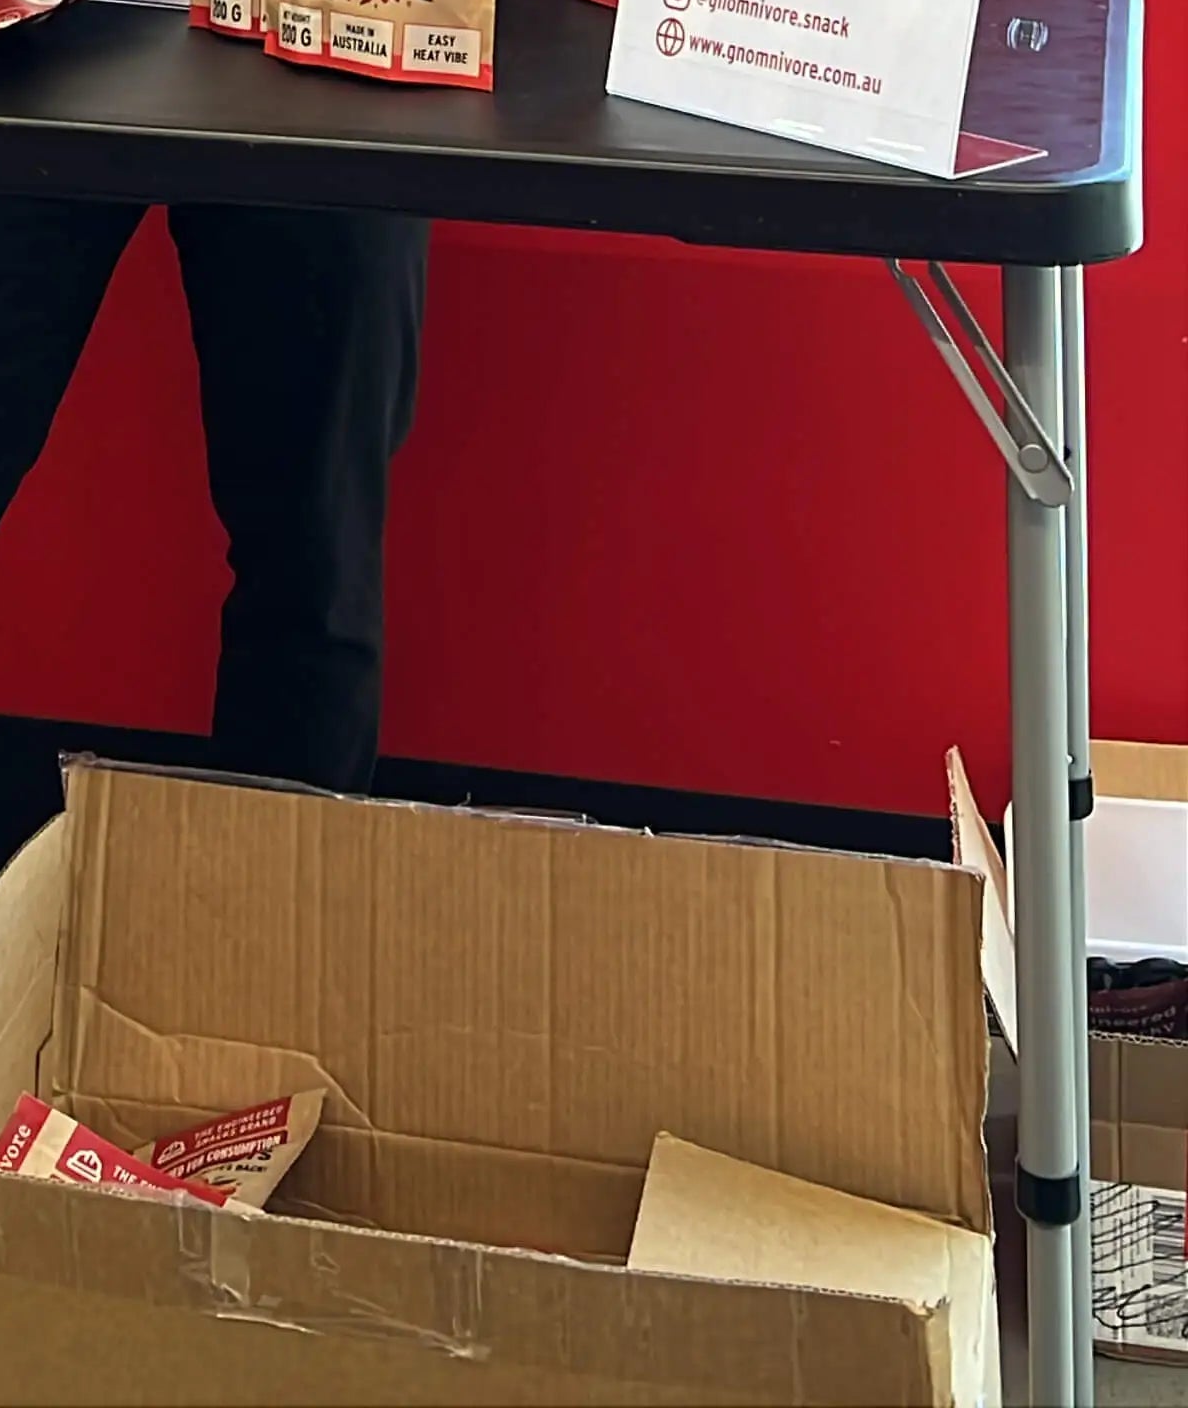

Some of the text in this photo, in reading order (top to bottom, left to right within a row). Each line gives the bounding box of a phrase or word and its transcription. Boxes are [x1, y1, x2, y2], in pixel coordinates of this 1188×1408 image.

[231, 5, 242, 23] G
[301, 29, 312, 47] G
[345, 23, 366, 36] MADE
[332, 37, 388, 58] AUSTRALIA
[427, 34, 456, 47] EASY
[413, 49, 469, 64] HEAT VIBE
[688, 34, 883, 95] www.gnomnivore.com.au
[206, 1134, 281, 1163] CONSUMPTION
